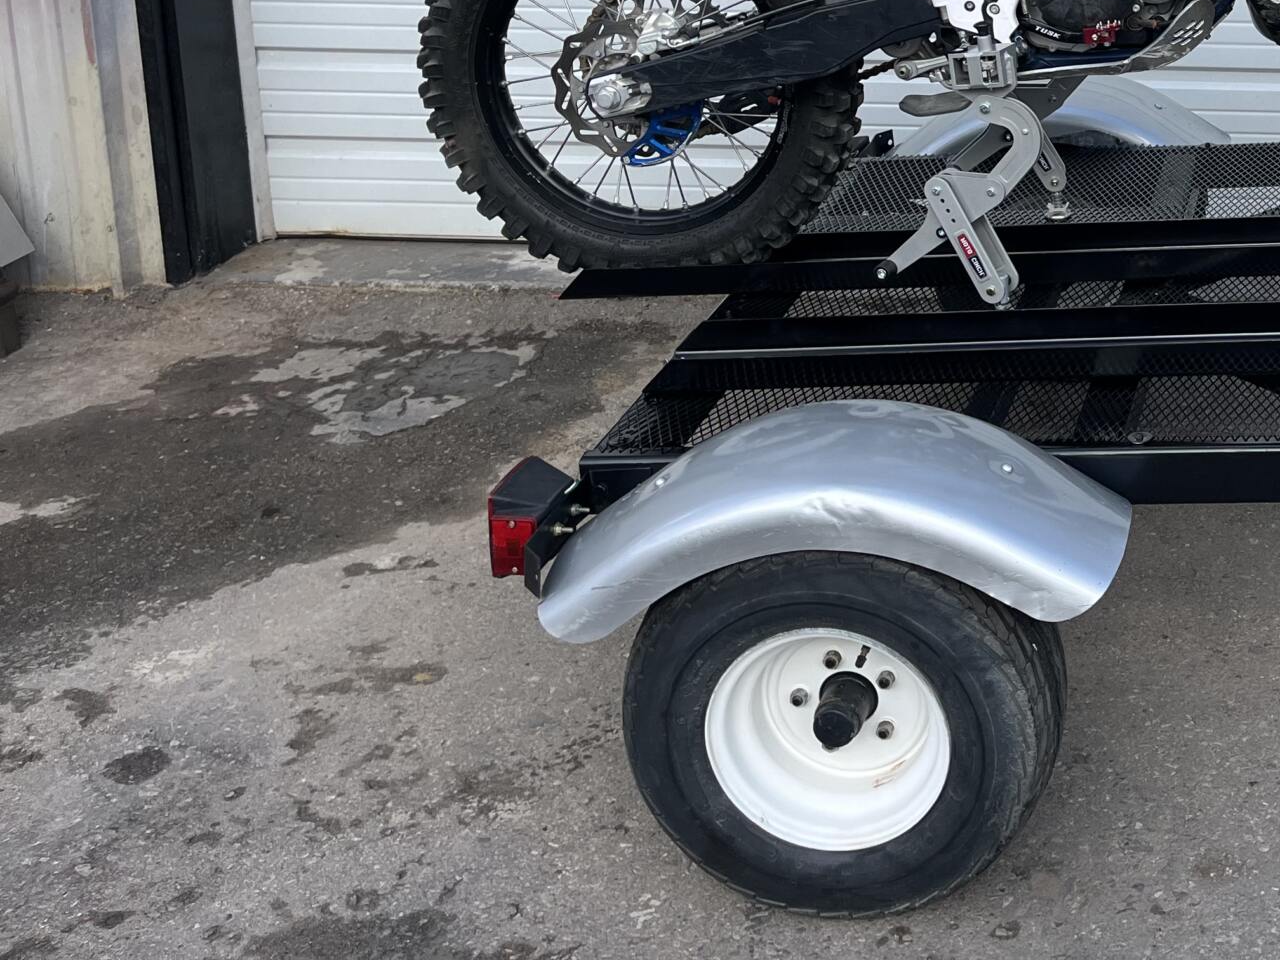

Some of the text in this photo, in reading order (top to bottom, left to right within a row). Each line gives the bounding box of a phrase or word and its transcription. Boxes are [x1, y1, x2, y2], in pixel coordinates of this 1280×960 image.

[1034, 25, 1062, 39] TUSK
[960, 238, 985, 276] MOTO CINCH
